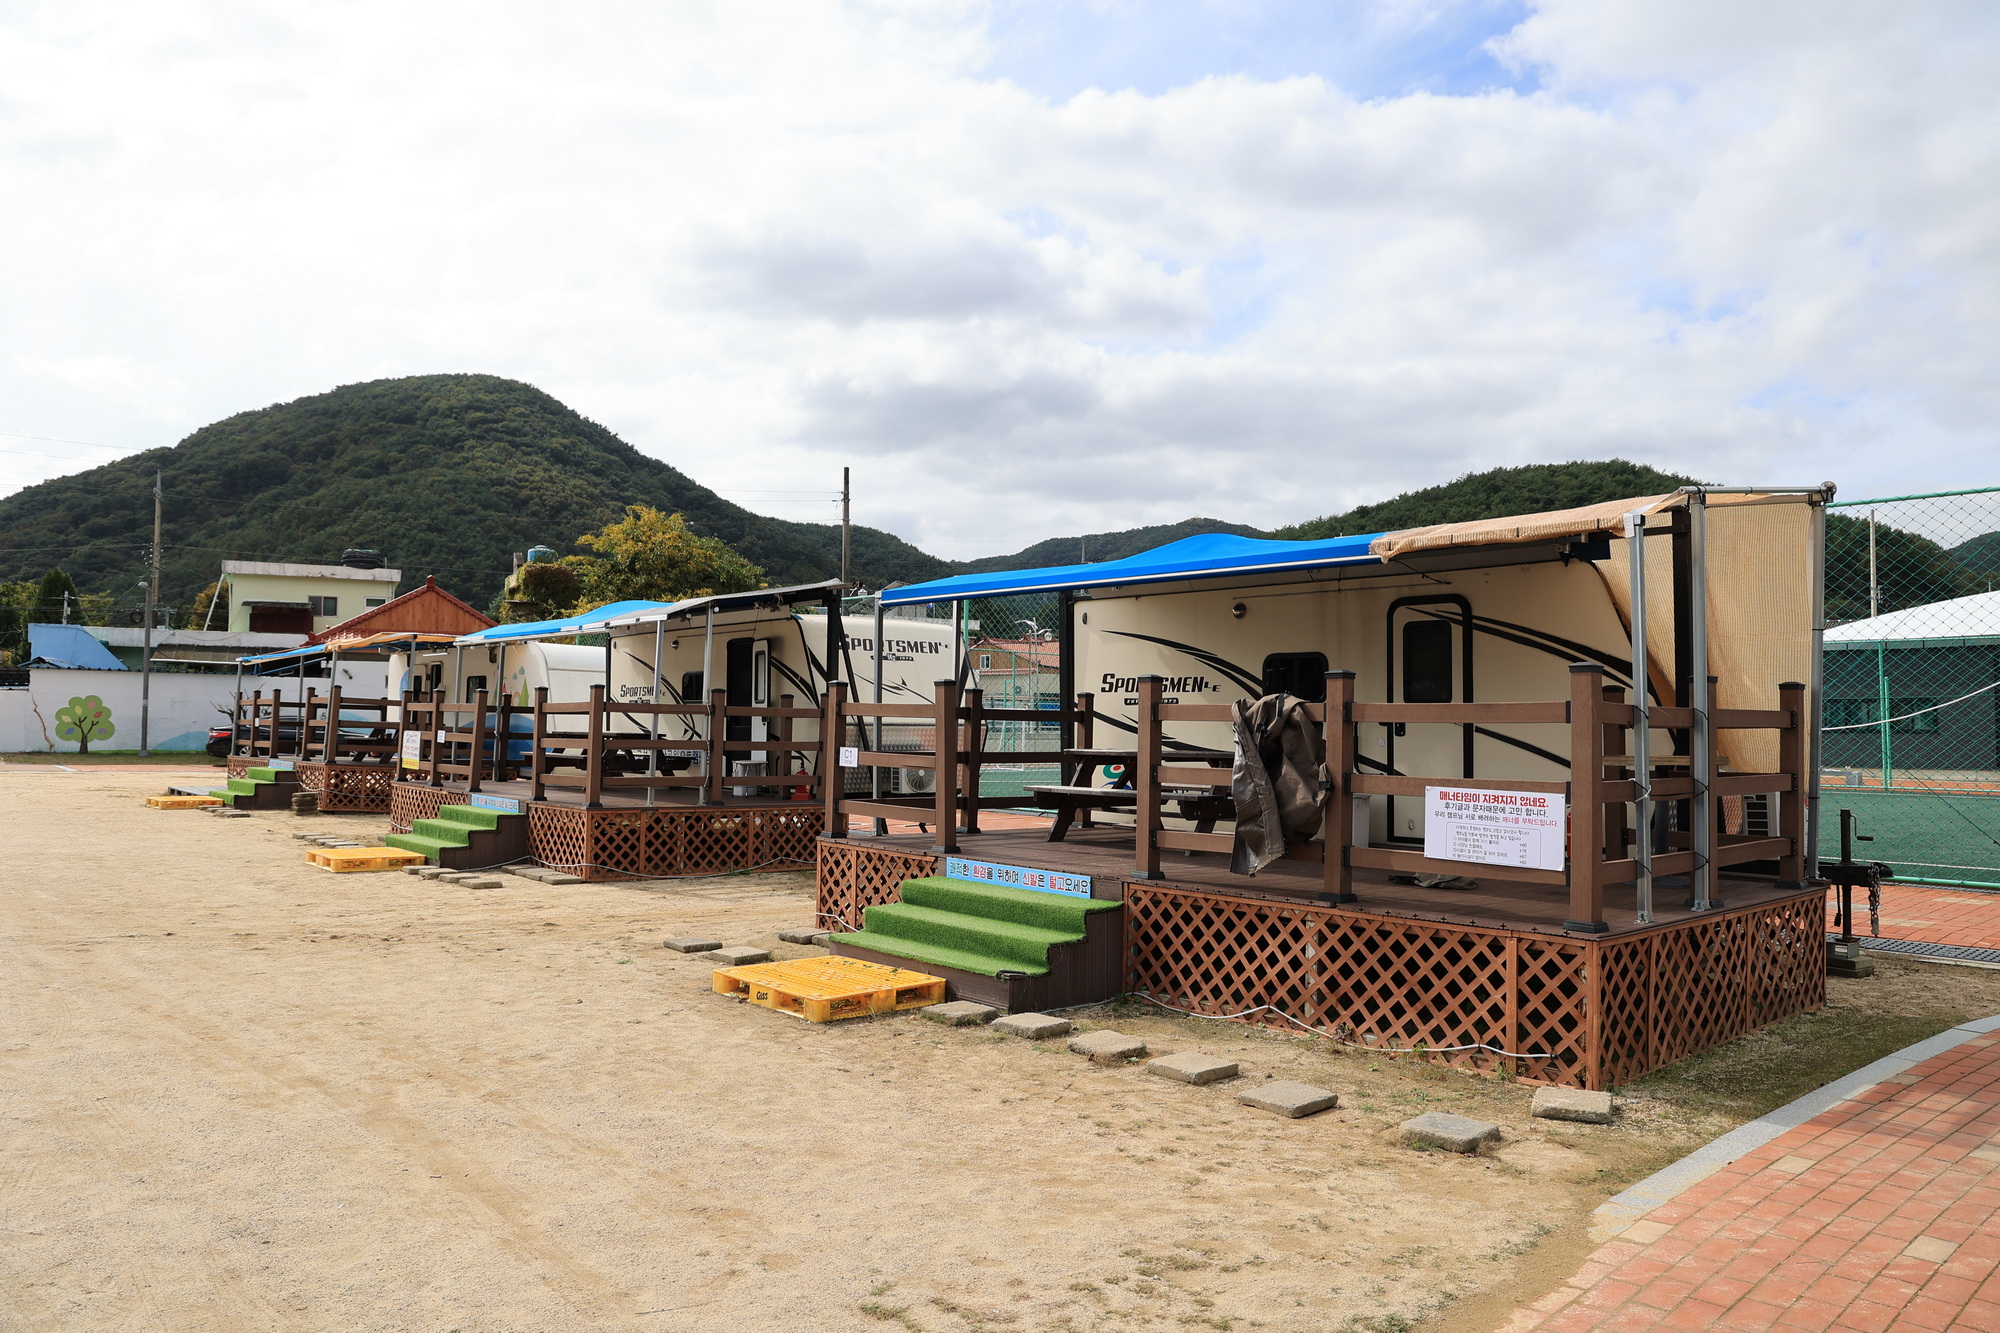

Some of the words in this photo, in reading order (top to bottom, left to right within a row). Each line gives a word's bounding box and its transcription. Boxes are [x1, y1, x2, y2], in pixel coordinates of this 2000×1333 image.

[1101, 673, 1204, 692] SPOSMEN
[1439, 791, 1480, 803] 매너타임이
[1482, 794, 1516, 806] 지켜지지
[1520, 796, 1548, 808] 않네요.
[1444, 802, 1470, 811] 후기글과
[1508, 807, 1523, 815] 고민
[973, 865, 994, 880] 환경을
[997, 868, 1018, 884] 위하여
[1023, 872, 1045, 887] 신발은
[1050, 876, 1088, 894] 털고오세요
